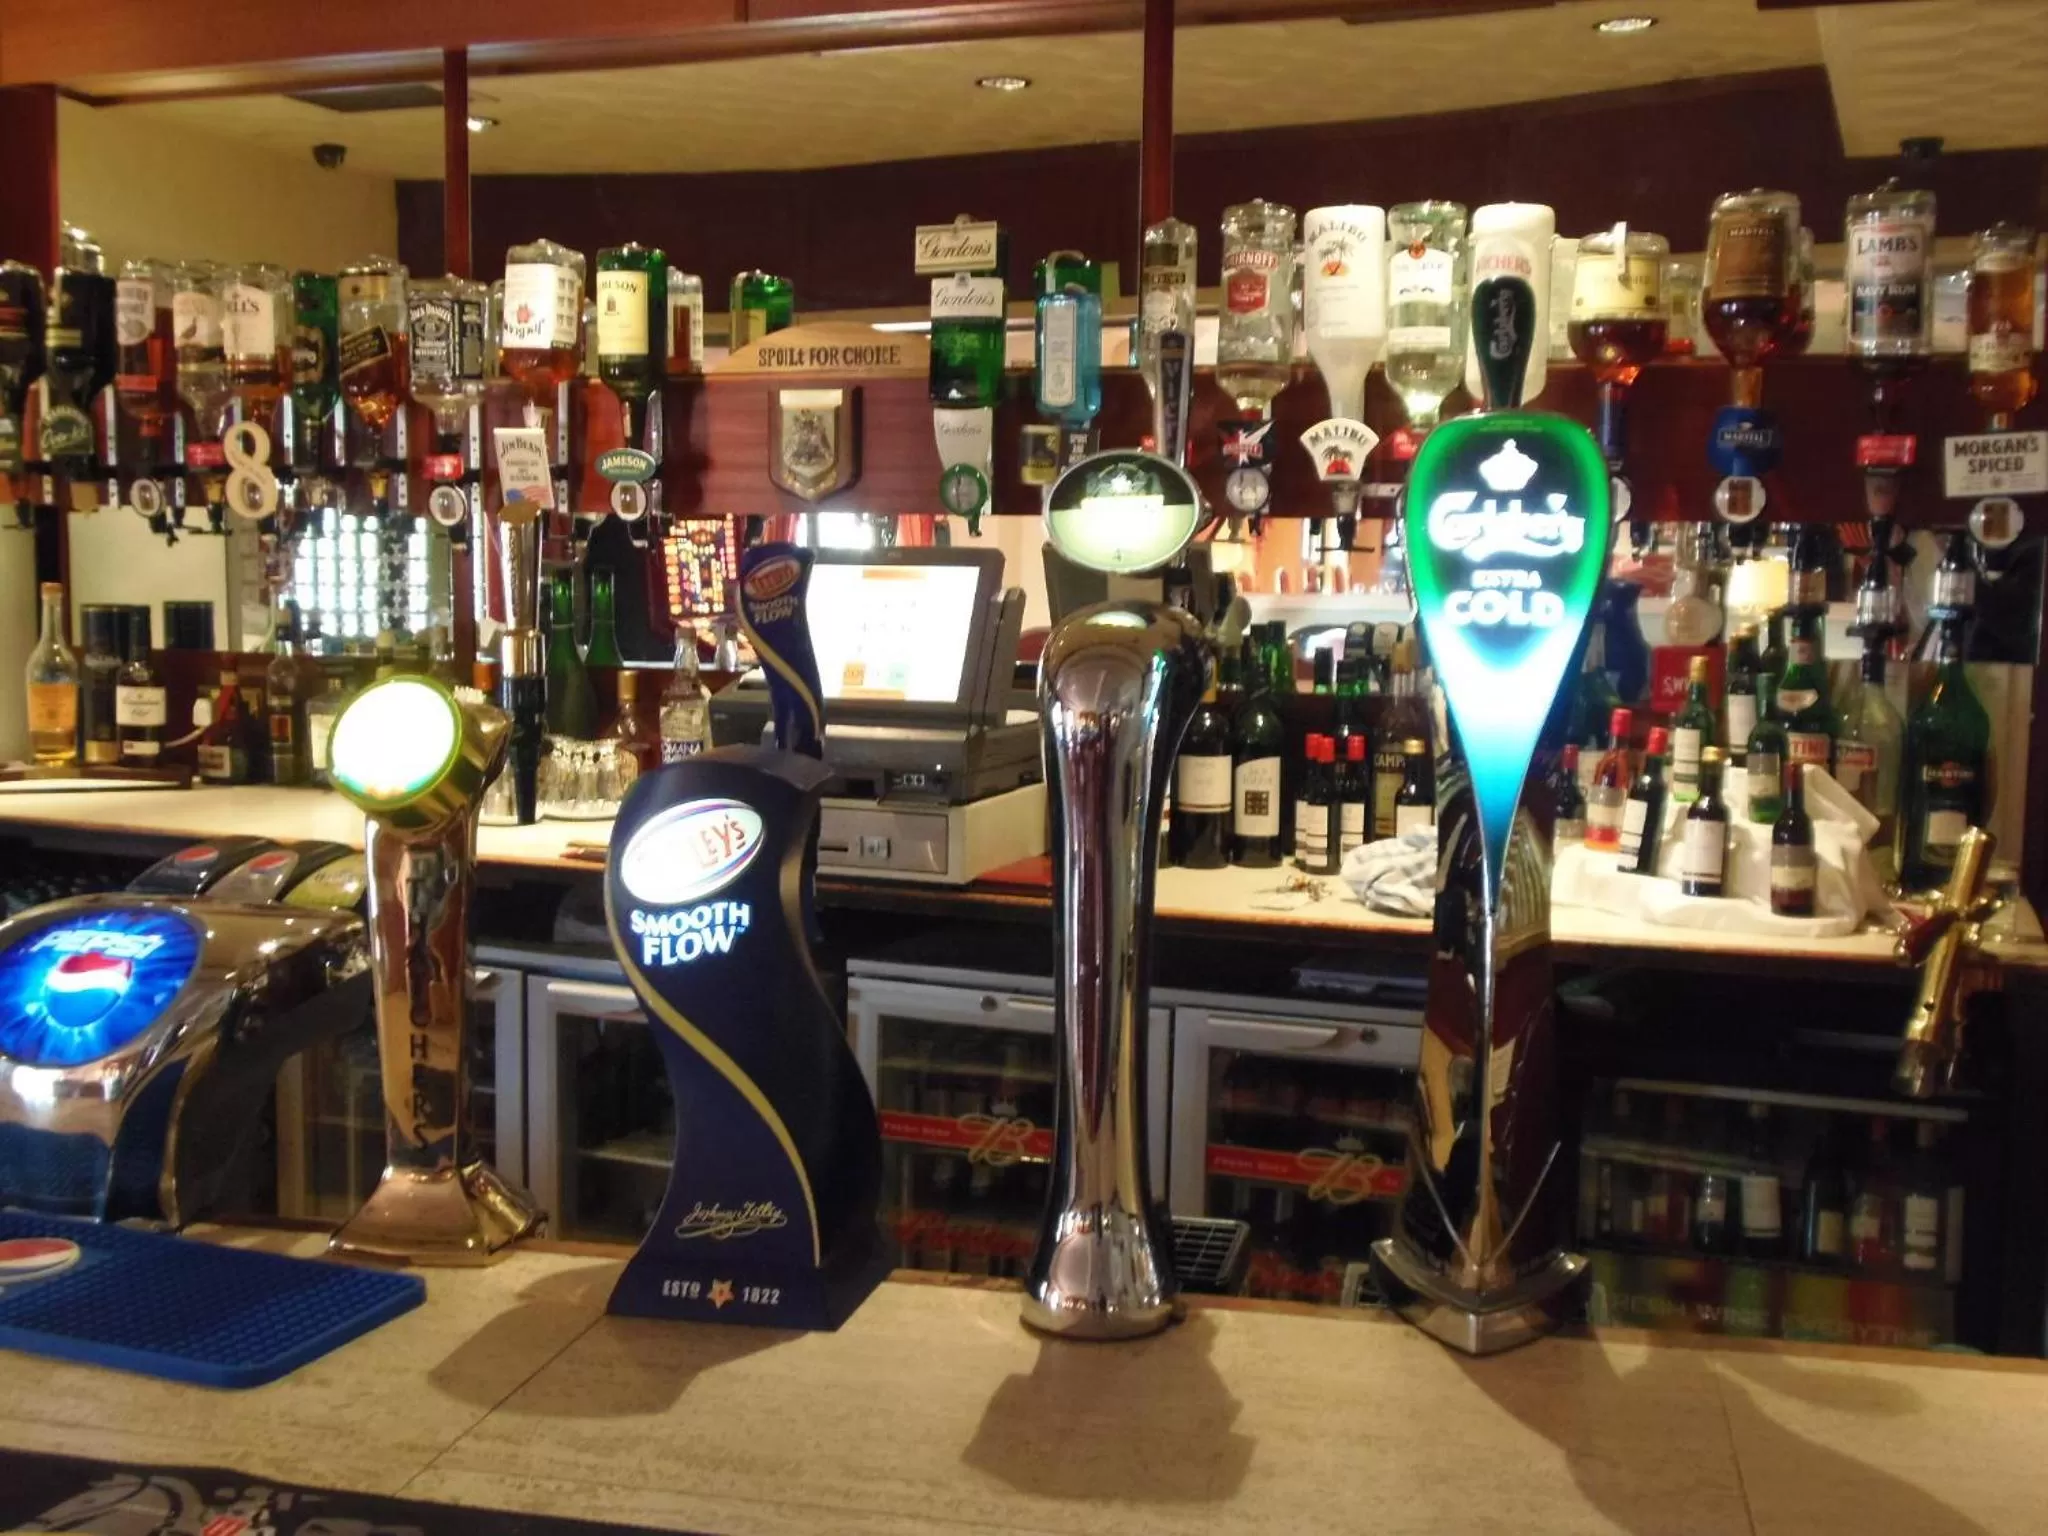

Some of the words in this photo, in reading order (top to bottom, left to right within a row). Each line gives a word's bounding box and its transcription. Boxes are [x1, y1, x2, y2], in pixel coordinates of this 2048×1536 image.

[919, 236, 994, 261] Gordon's
[809, 347, 839, 366] FOR
[842, 345, 900, 365] CHOICE
[1308, 424, 1369, 447] MALIBU
[1953, 436, 2041, 458] MORGAN'S
[601, 456, 647, 472] JAMESON
[1967, 459, 2025, 475] SPICED
[1443, 590, 1565, 628] COLD
[629, 902, 750, 937] SMOOTH
[29, 928, 165, 961] PEPSI
[643, 924, 738, 966] FLOW
[742, 1286, 780, 1305] 1822
